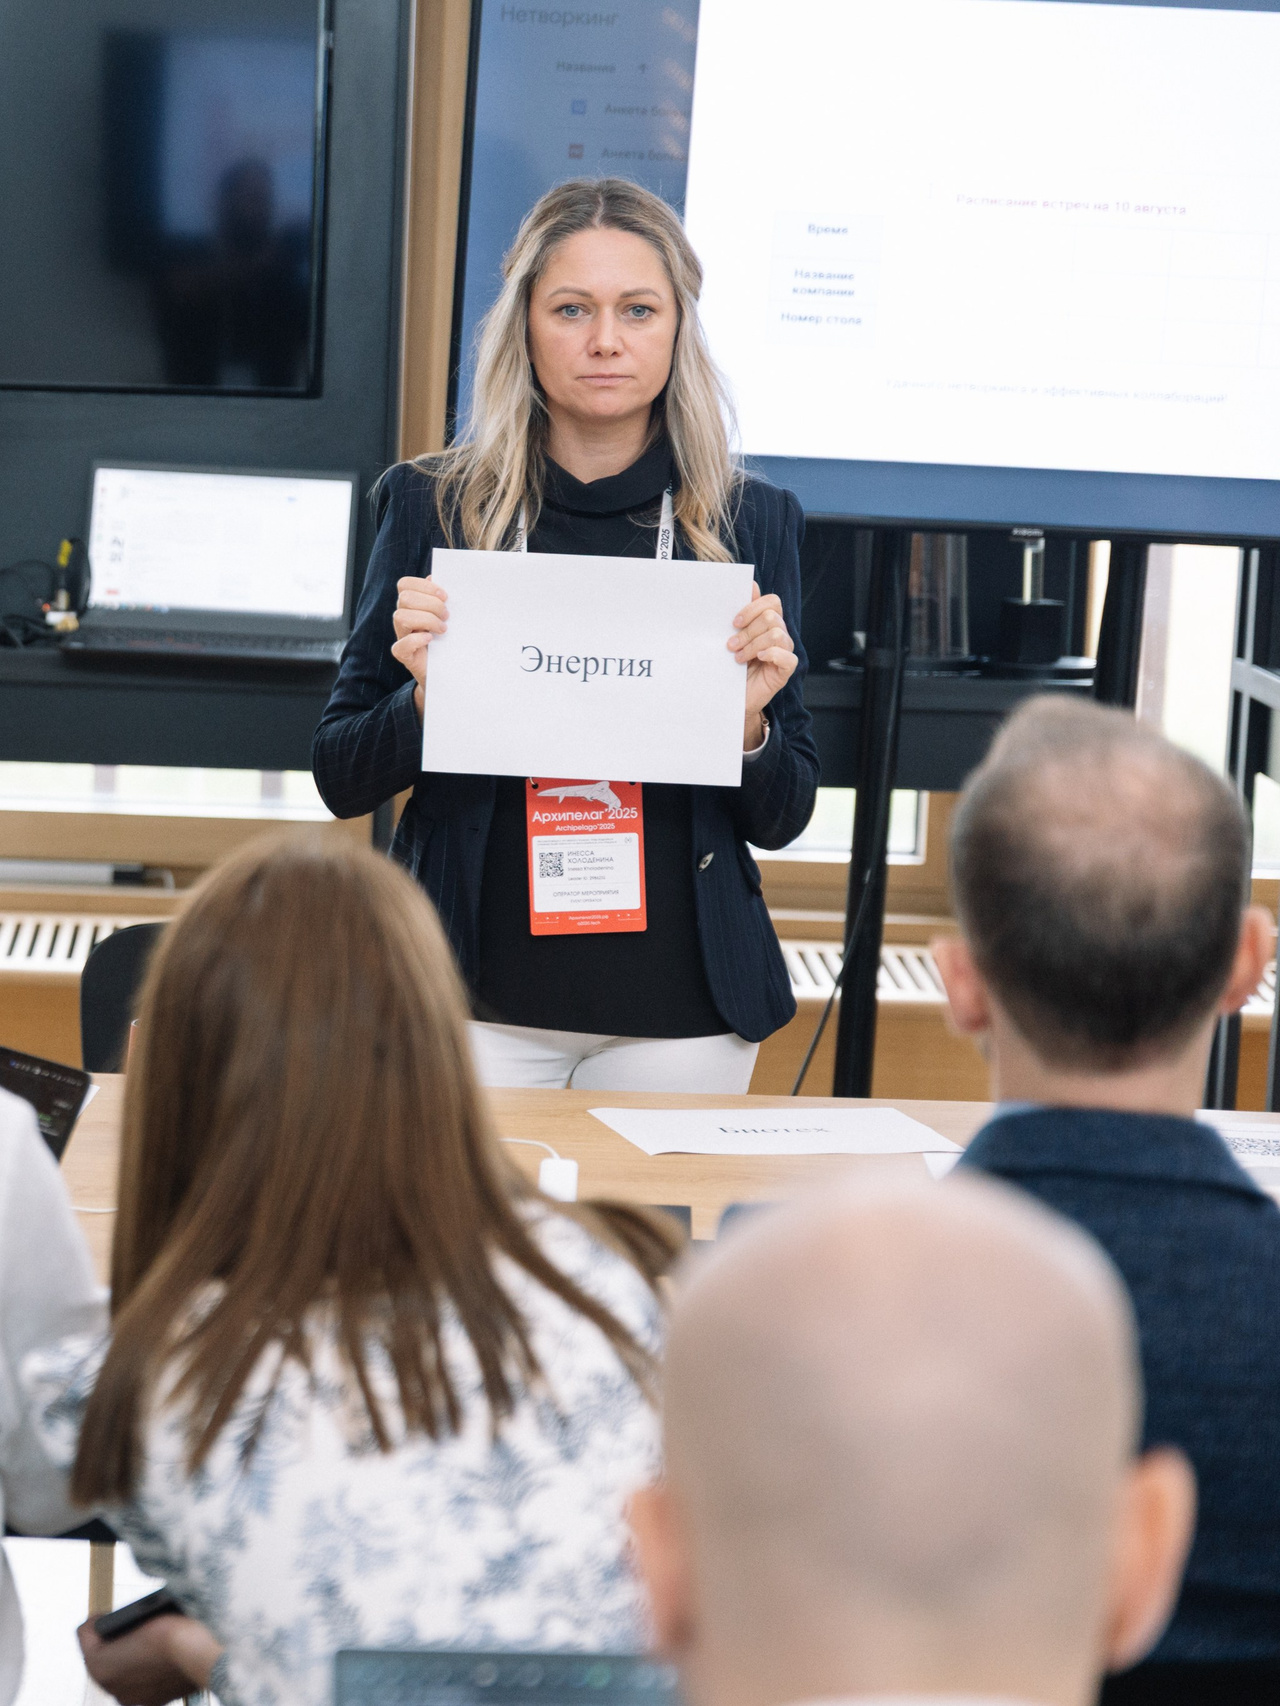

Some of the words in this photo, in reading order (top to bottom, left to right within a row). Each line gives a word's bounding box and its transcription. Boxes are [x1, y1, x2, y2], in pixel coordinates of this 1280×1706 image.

[501, 5, 620, 28] Нетворкинг
[556, 60, 617, 75] Название
[956, 193, 1037, 208] Расписание
[1042, 198, 1090, 212] встреч
[1094, 202, 1110, 212] на
[1134, 202, 1187, 216] августа
[794, 267, 855, 281] Название
[792, 285, 855, 297] компании
[780, 311, 822, 326] Номер
[520, 644, 654, 682] Энергия
